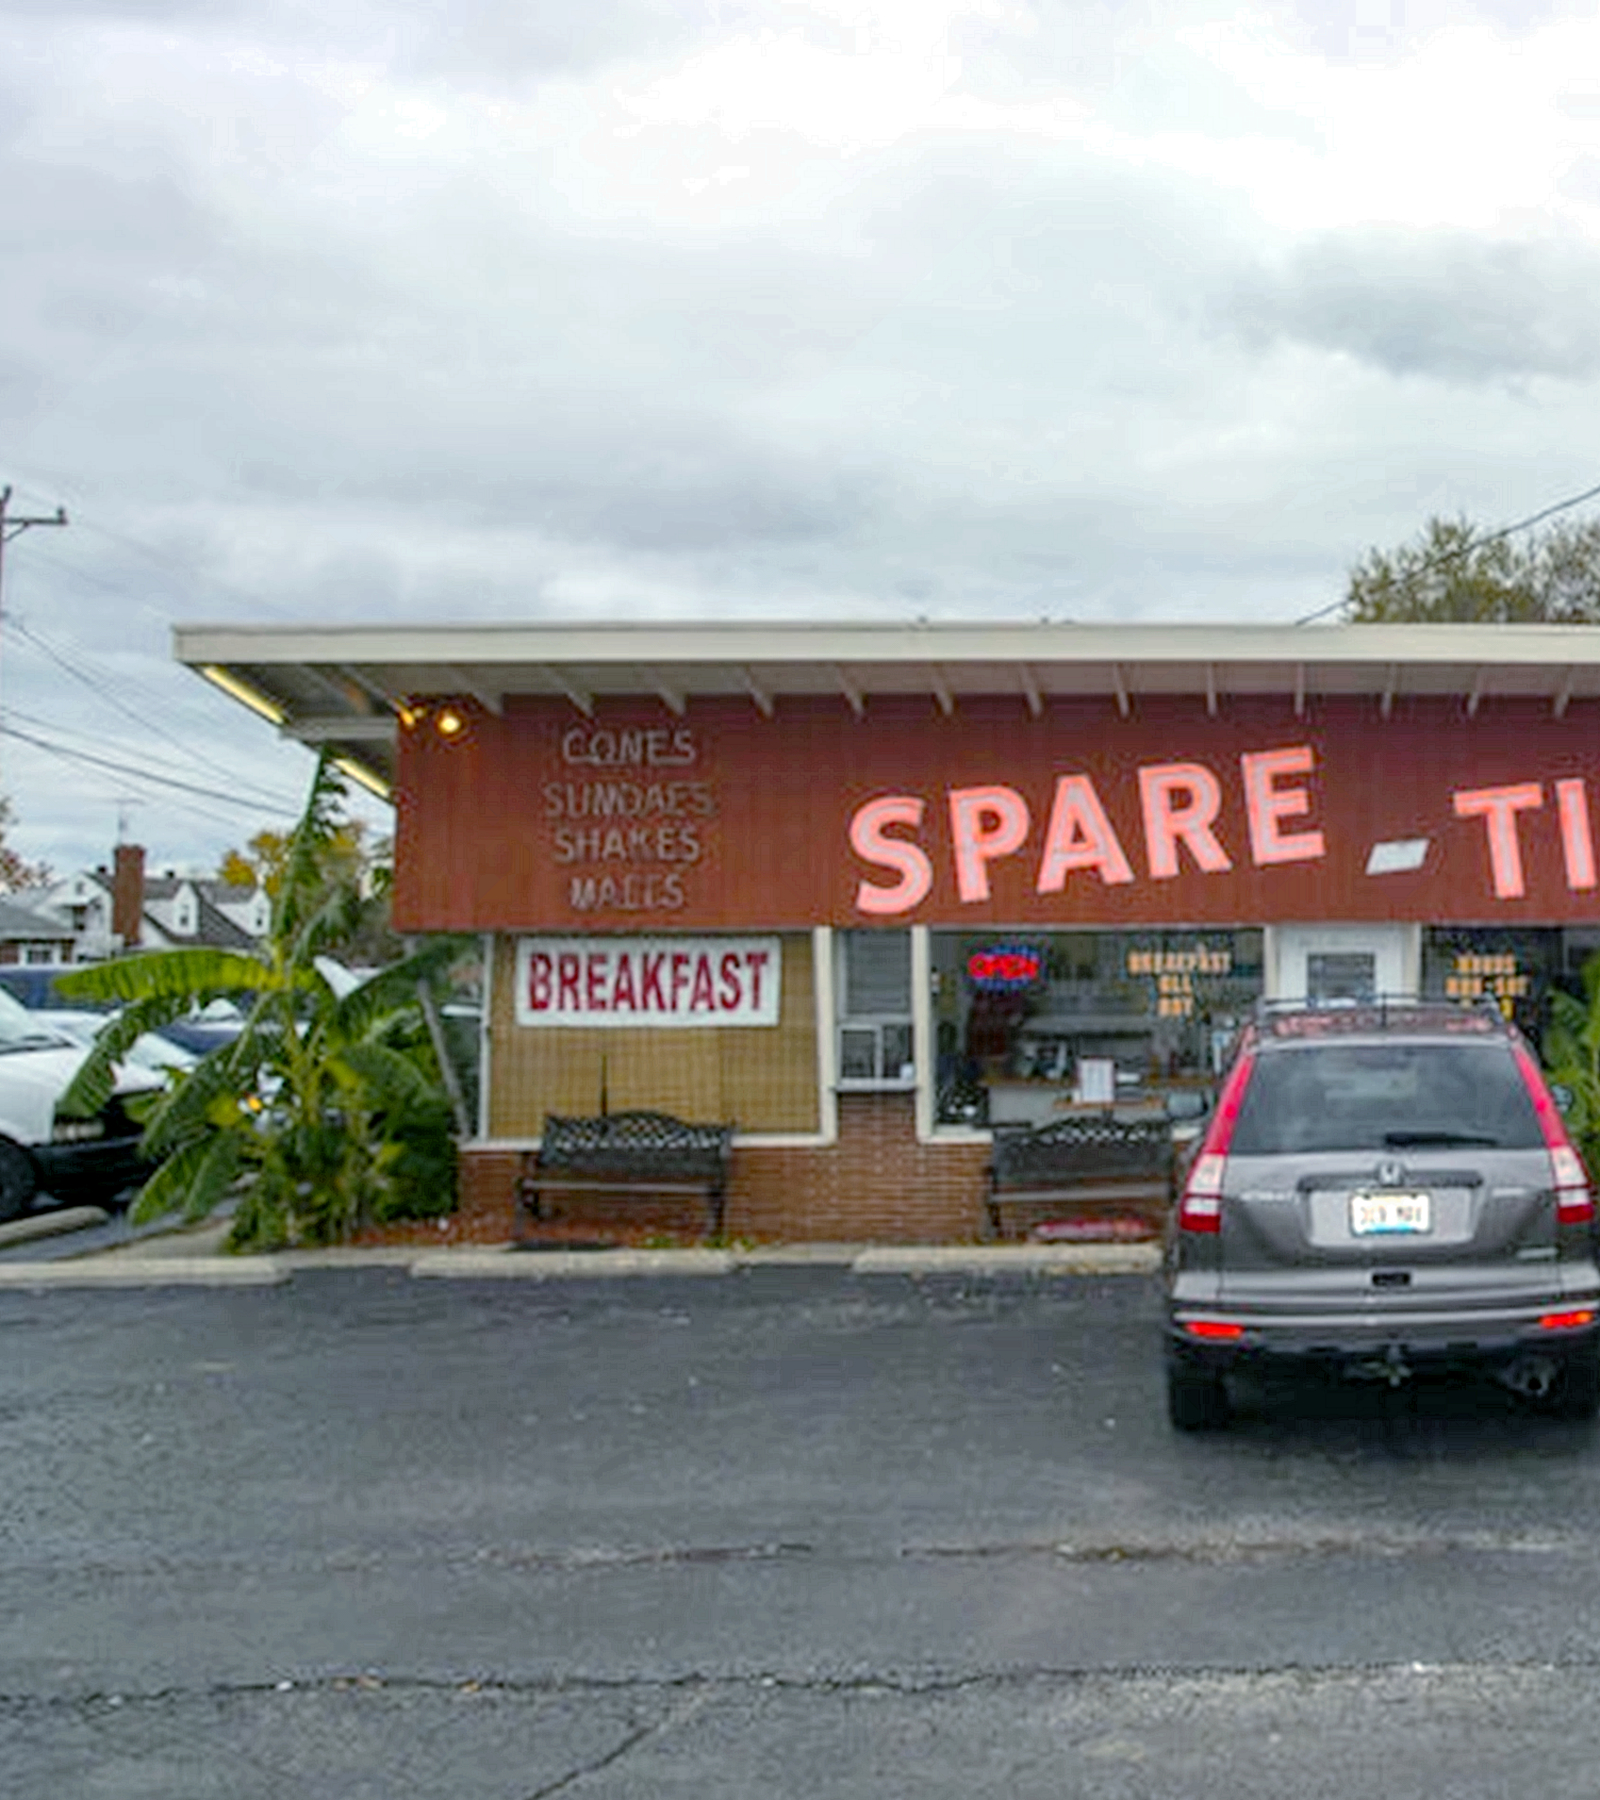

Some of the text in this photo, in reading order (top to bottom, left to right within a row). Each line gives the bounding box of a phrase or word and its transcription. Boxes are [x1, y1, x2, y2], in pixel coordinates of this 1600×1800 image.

[562, 728, 698, 766] CONES
[543, 780, 718, 818] SUNDAES
[552, 827, 702, 864] SHAKES
[848, 745, 1327, 914] SPARE
[569, 872, 686, 910] MALTS
[528, 951, 769, 1012] BREAKFAST
